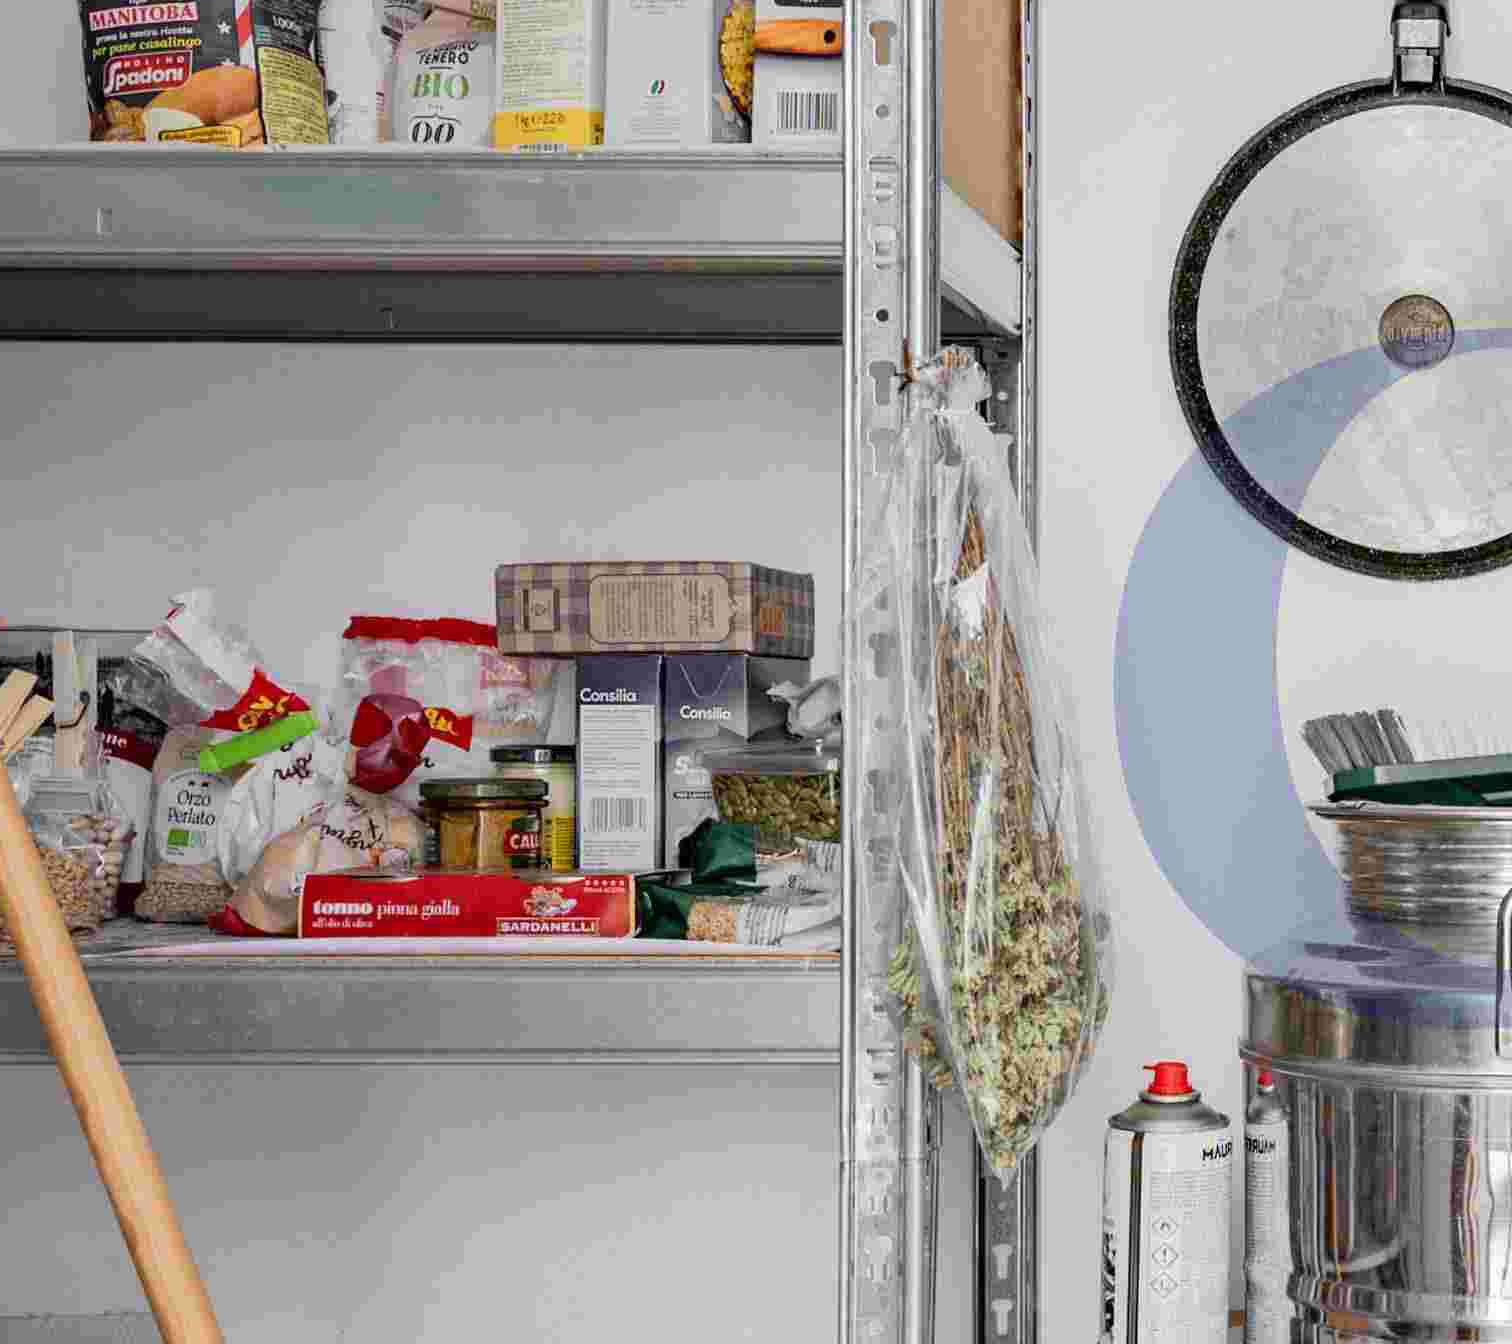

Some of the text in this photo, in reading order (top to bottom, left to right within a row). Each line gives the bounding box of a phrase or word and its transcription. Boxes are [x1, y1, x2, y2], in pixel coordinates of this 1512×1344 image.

[91, 4, 198, 29] MANITOBA
[103, 62, 185, 96] Spadoni
[580, 688, 638, 704] Consilia
[679, 705, 732, 721] Consilia
[176, 790, 212, 807] Orzo
[311, 899, 374, 915] tonno
[377, 900, 418, 919] pinna
[500, 921, 596, 933] SARDANELLI
